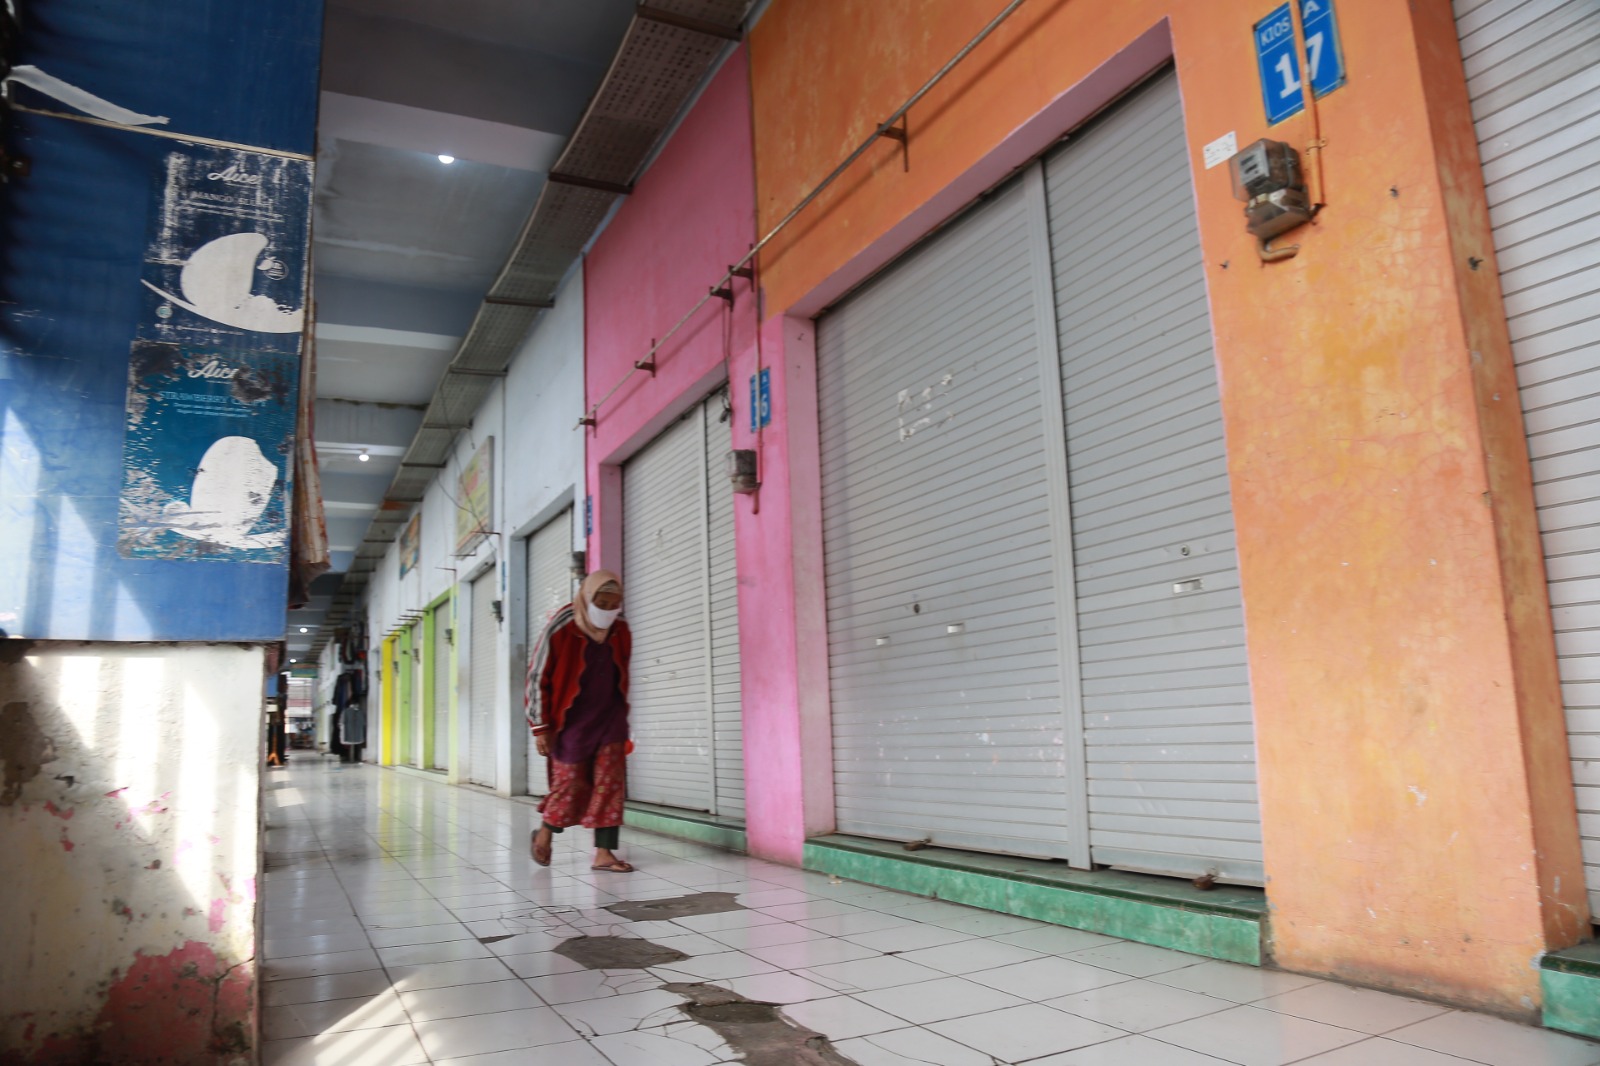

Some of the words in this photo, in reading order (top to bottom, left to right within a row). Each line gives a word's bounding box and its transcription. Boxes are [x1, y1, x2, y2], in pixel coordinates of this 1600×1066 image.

[1260, 16, 1290, 46] KIOS
[1303, 0, 1320, 19] A
[1275, 31, 1323, 99] 17
[207, 165, 261, 185] Aice
